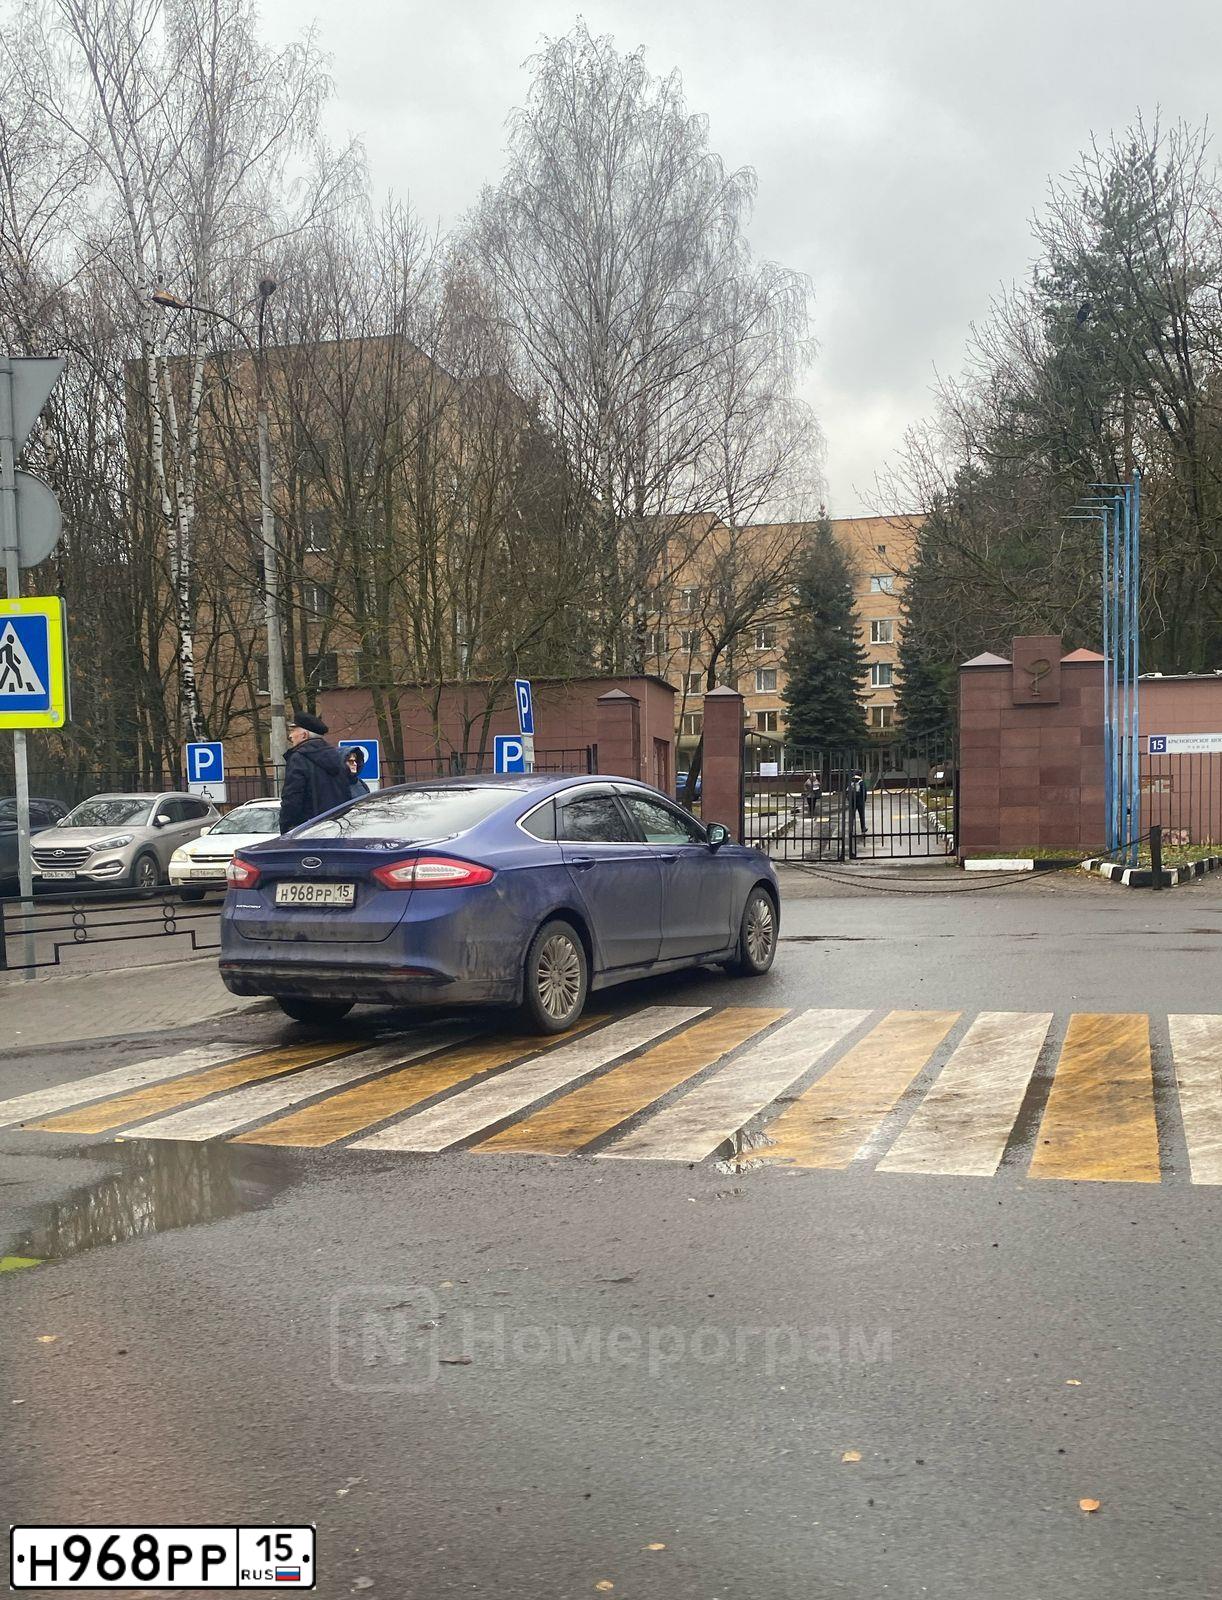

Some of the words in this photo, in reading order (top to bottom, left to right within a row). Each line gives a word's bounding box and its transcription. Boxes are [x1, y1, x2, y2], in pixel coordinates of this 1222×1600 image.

[519, 686, 529, 729] P
[503, 741, 523, 773] P
[1151, 740, 1164, 750] 15
[194, 748, 214, 779] P
[281, 885, 332, 901] Н968РР
[337, 885, 350, 898] 15
